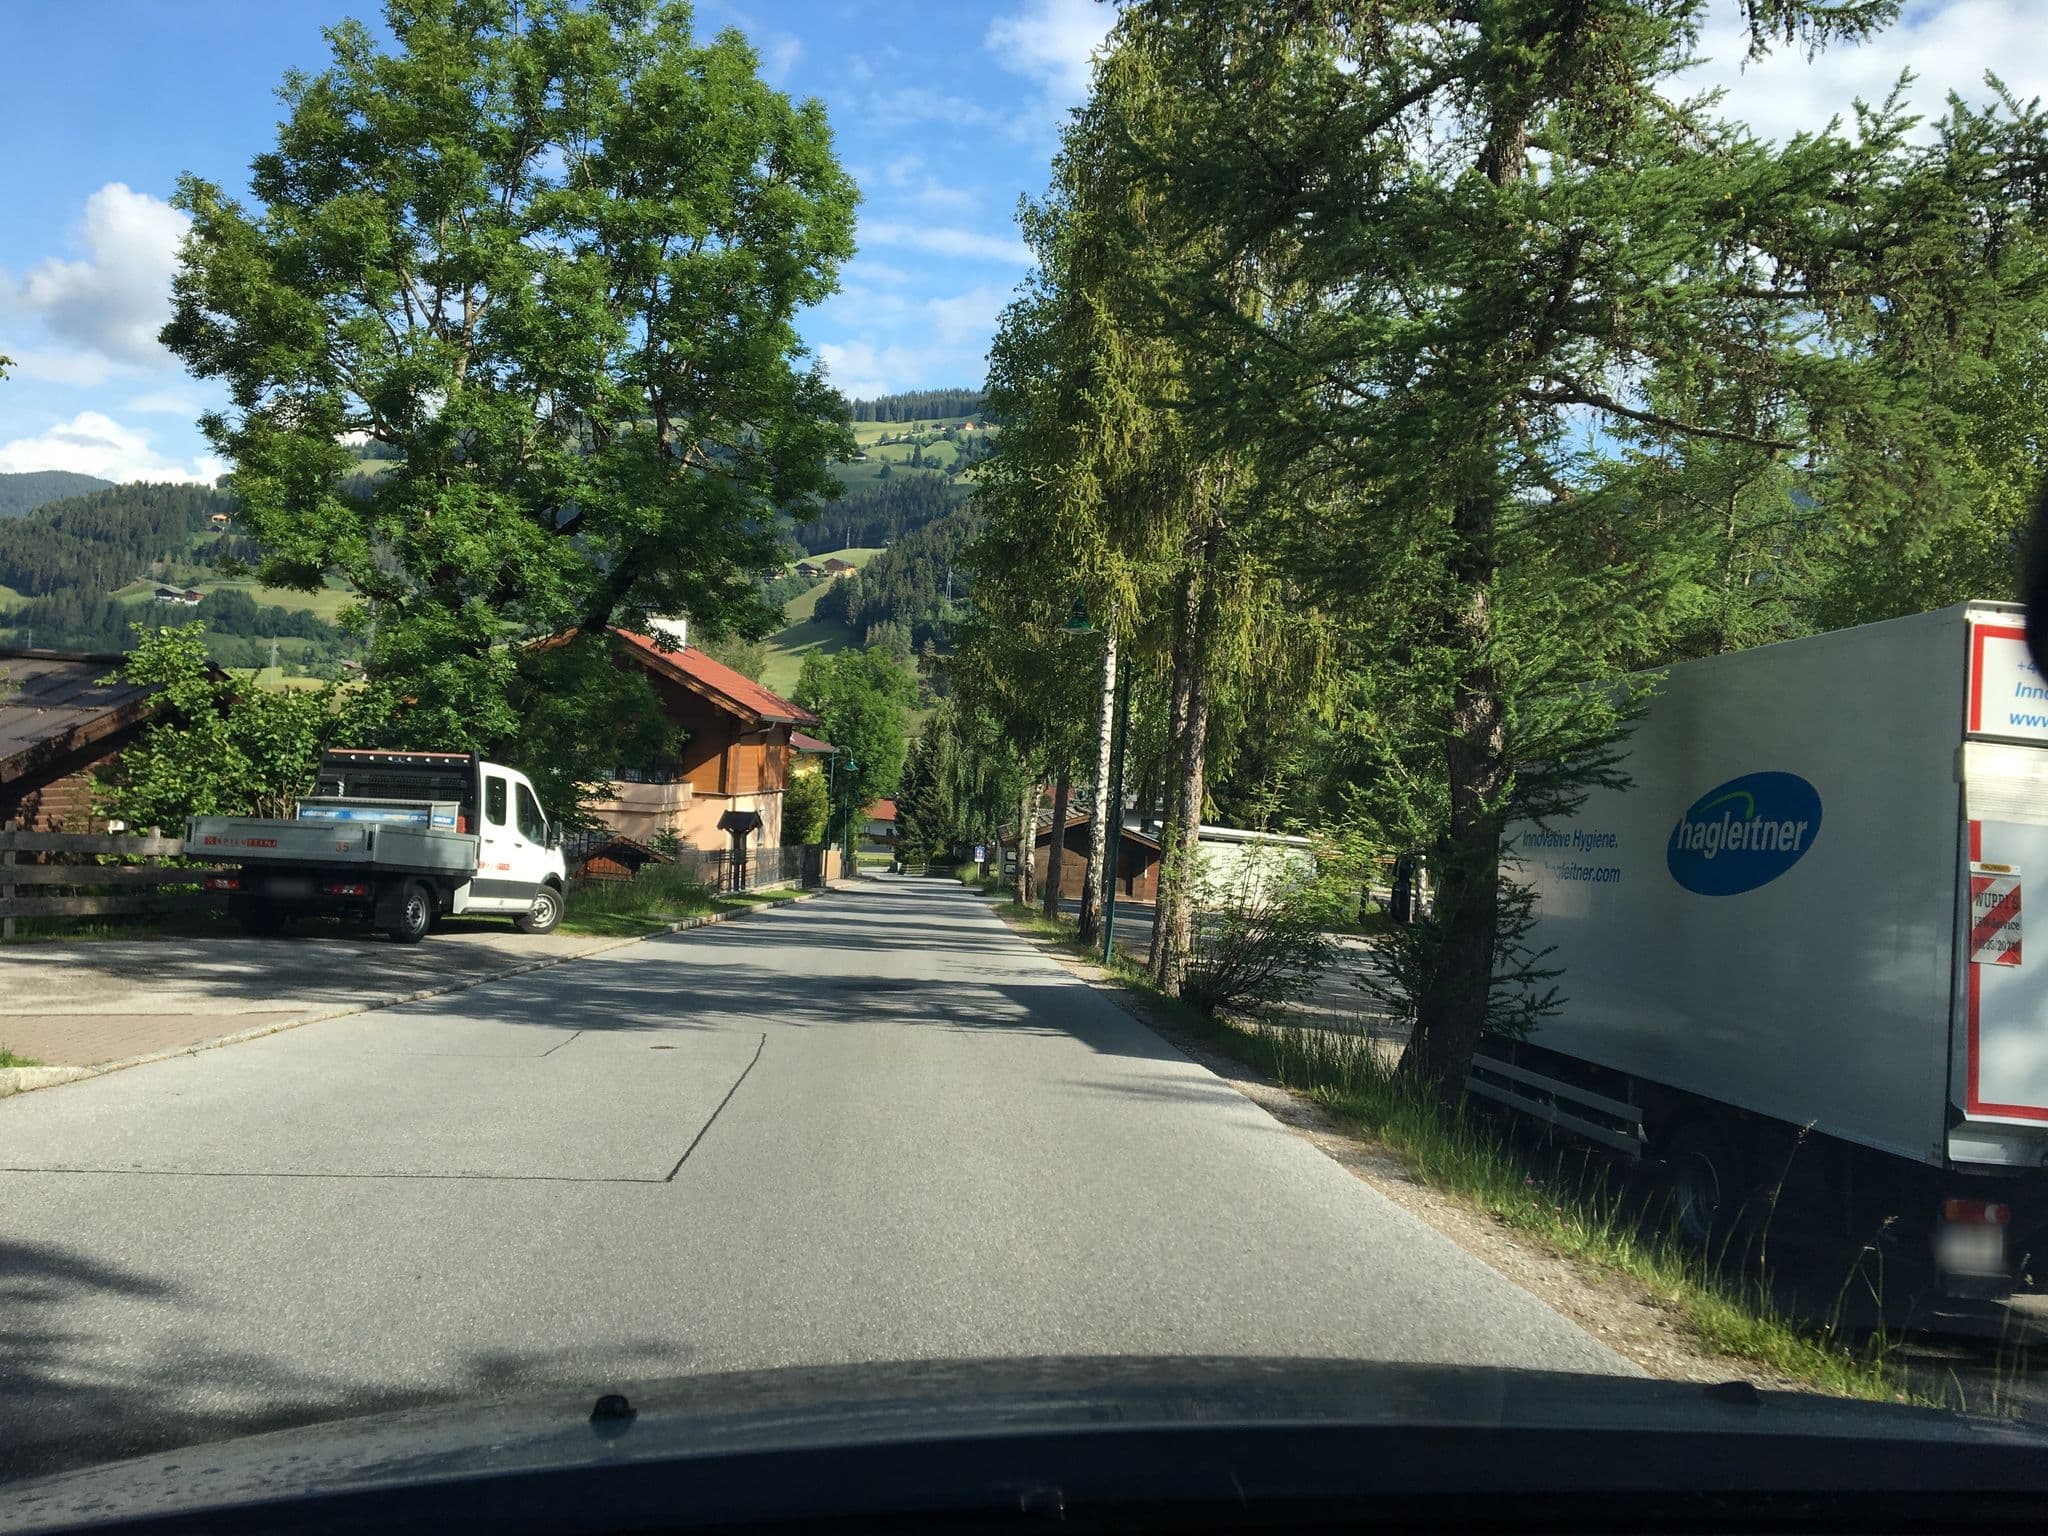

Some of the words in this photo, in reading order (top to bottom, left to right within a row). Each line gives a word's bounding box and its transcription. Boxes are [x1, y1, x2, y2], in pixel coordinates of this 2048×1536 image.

[1522, 829, 1571, 848] Innovative
[1572, 828, 1618, 853] Hygiene.
[1677, 811, 1808, 859] hagleitner
